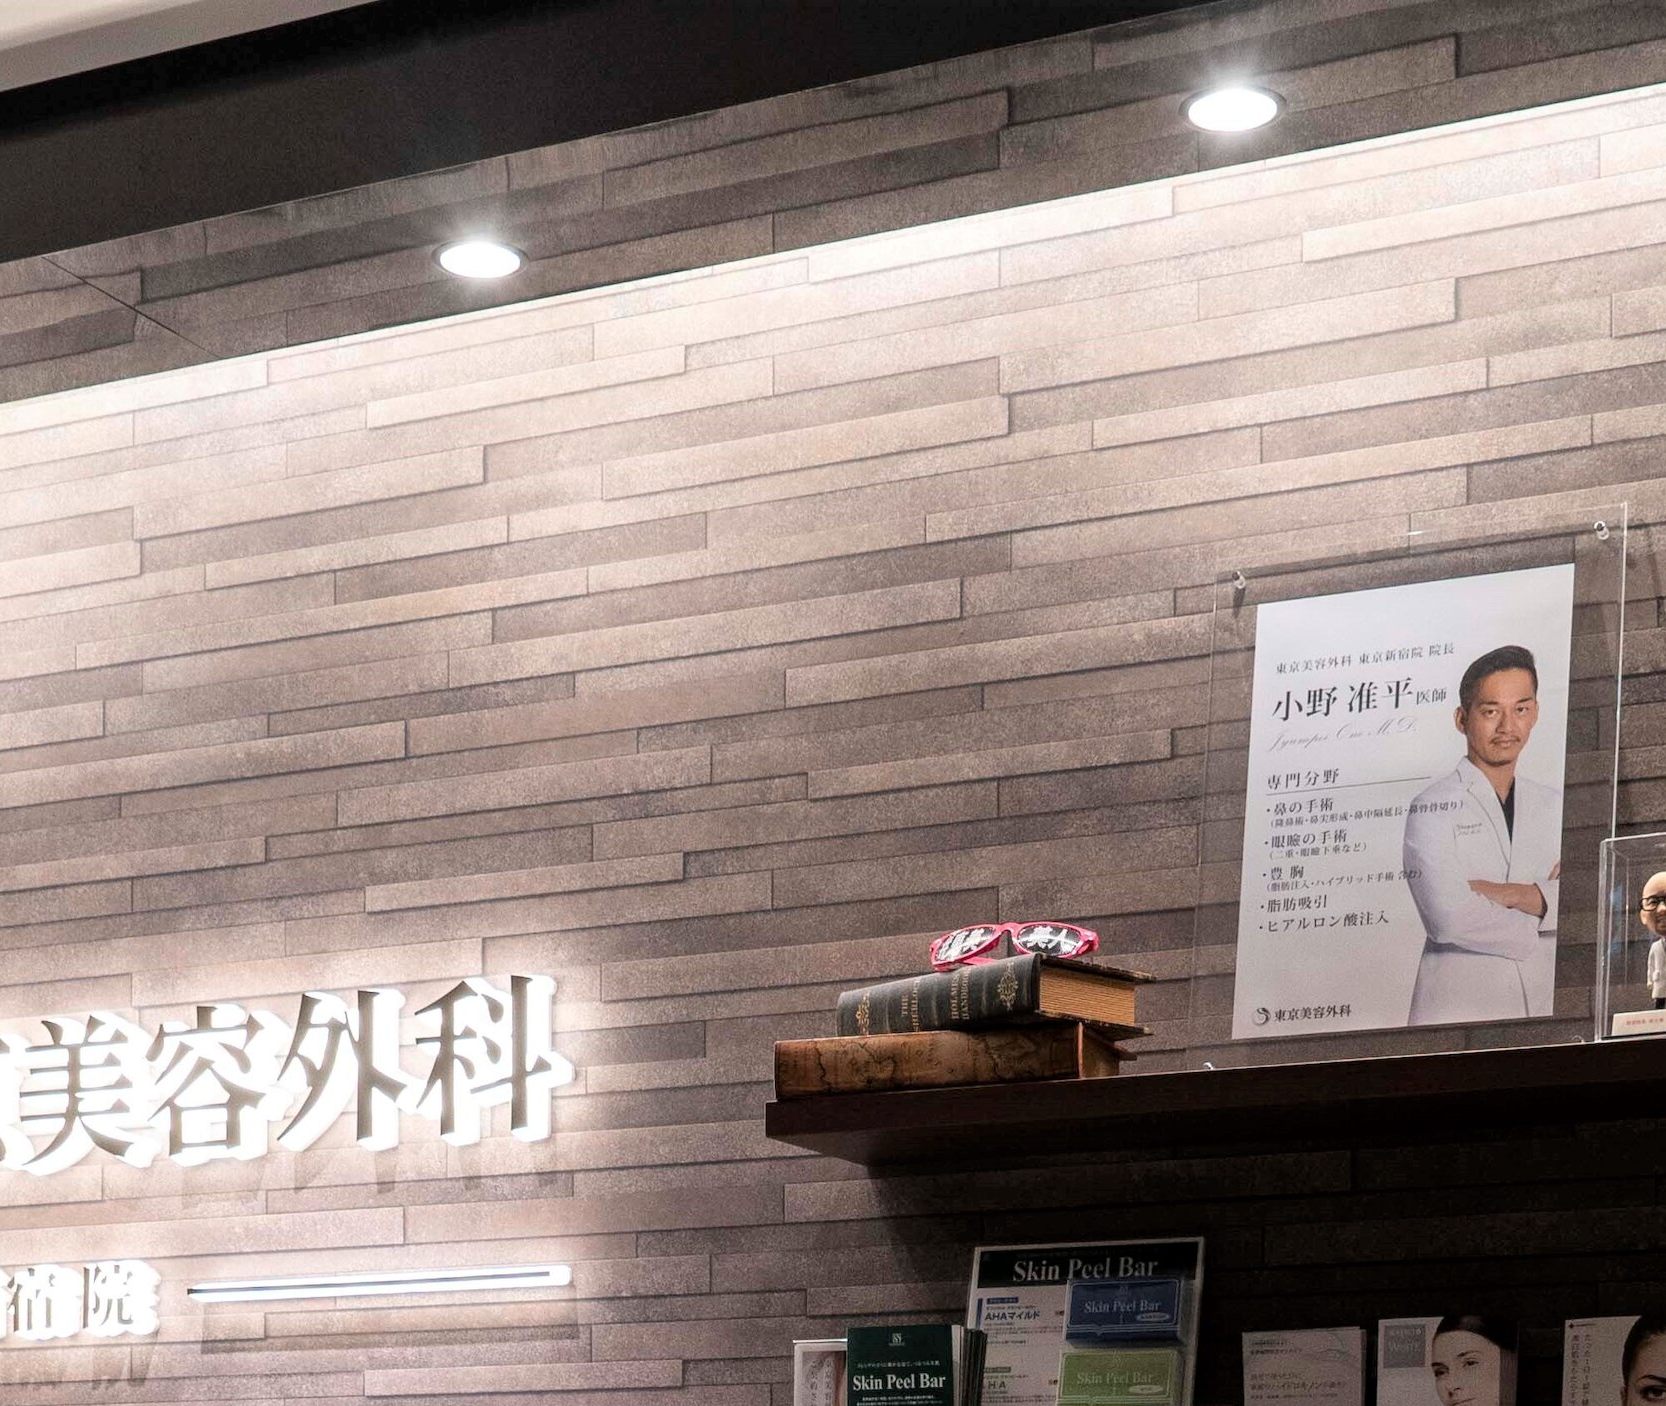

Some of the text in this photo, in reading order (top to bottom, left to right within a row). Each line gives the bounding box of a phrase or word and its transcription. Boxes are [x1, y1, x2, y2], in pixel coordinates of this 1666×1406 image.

[1276, 642, 1454, 674] 東京美容外科 東京新宿院 院長
[1273, 677, 1446, 721] 小野 准平 医師
[1267, 768, 1339, 790] 専門分野
[1275, 1004, 1352, 1022] 東京美容外科
[1012, 1256, 1159, 1282] Skin Peel Bar
[984, 1311, 1040, 1321] AHAマイルド
[1085, 1300, 1161, 1313] Skin Peel Bar
[852, 1372, 947, 1392] Skin Peel Bar
